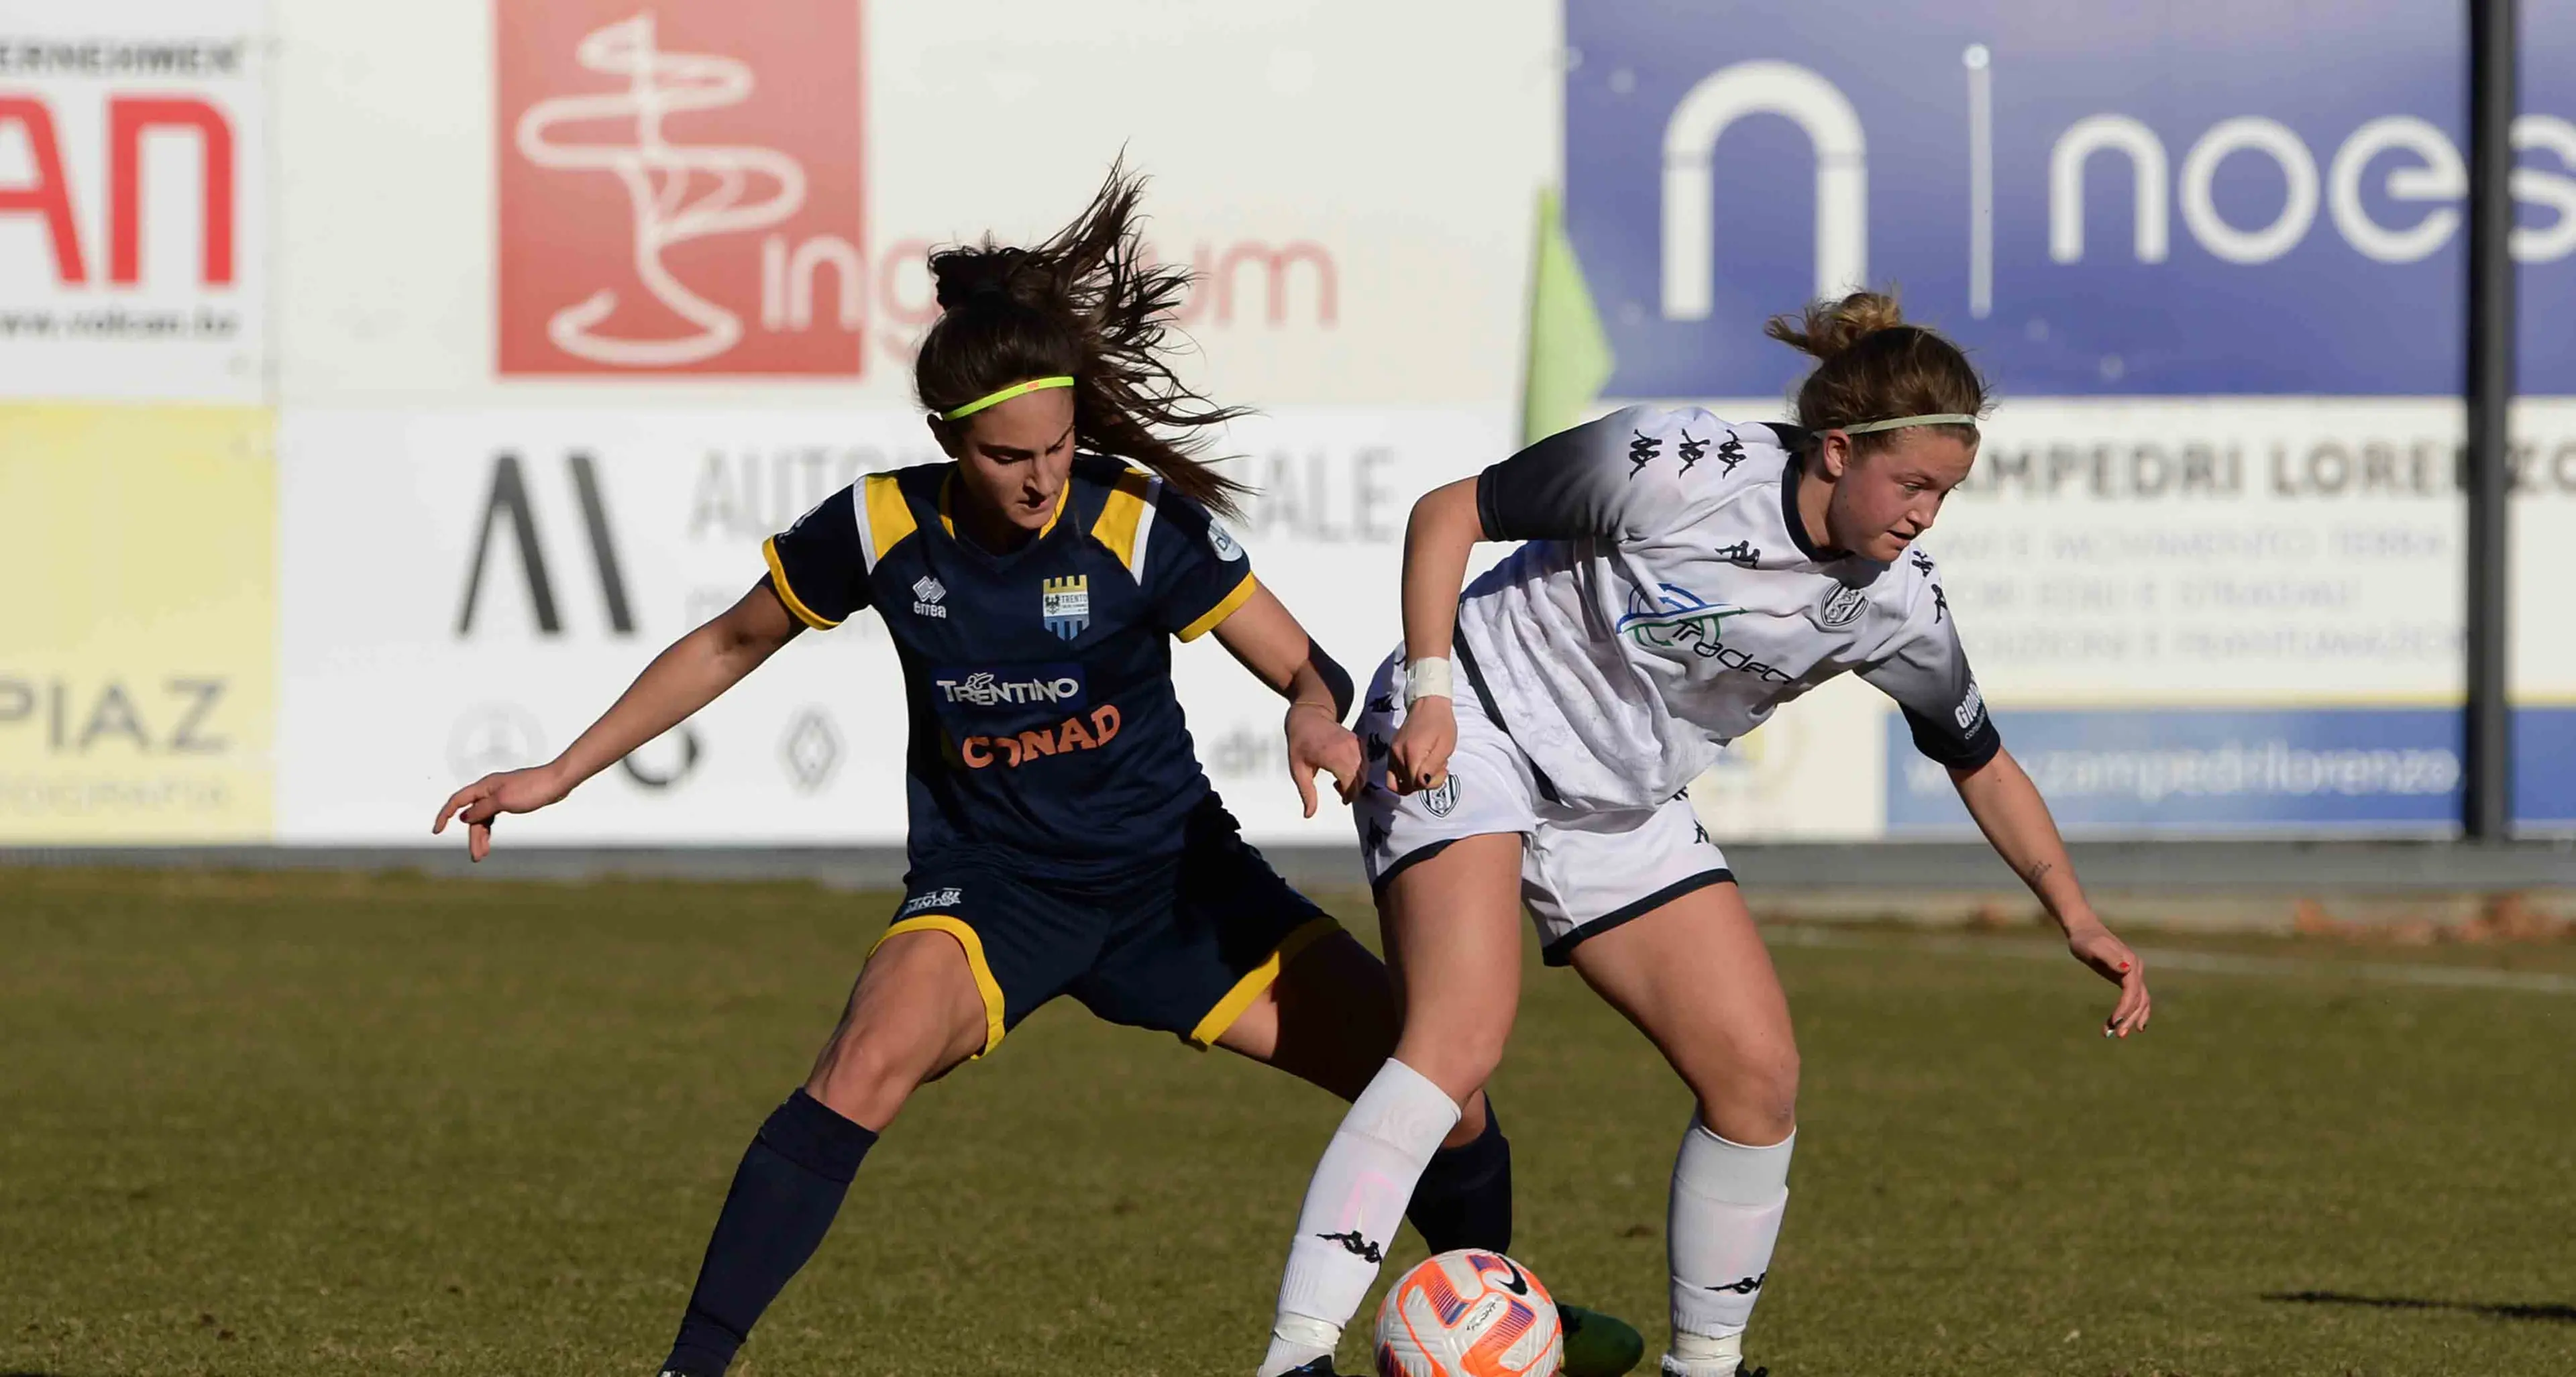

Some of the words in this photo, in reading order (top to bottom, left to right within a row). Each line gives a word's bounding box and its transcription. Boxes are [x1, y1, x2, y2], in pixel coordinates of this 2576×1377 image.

[2269, 440, 2576, 500] LOREZO
[936, 676, 1079, 706] TRENTINO
[962, 704, 1121, 769] CONAD
